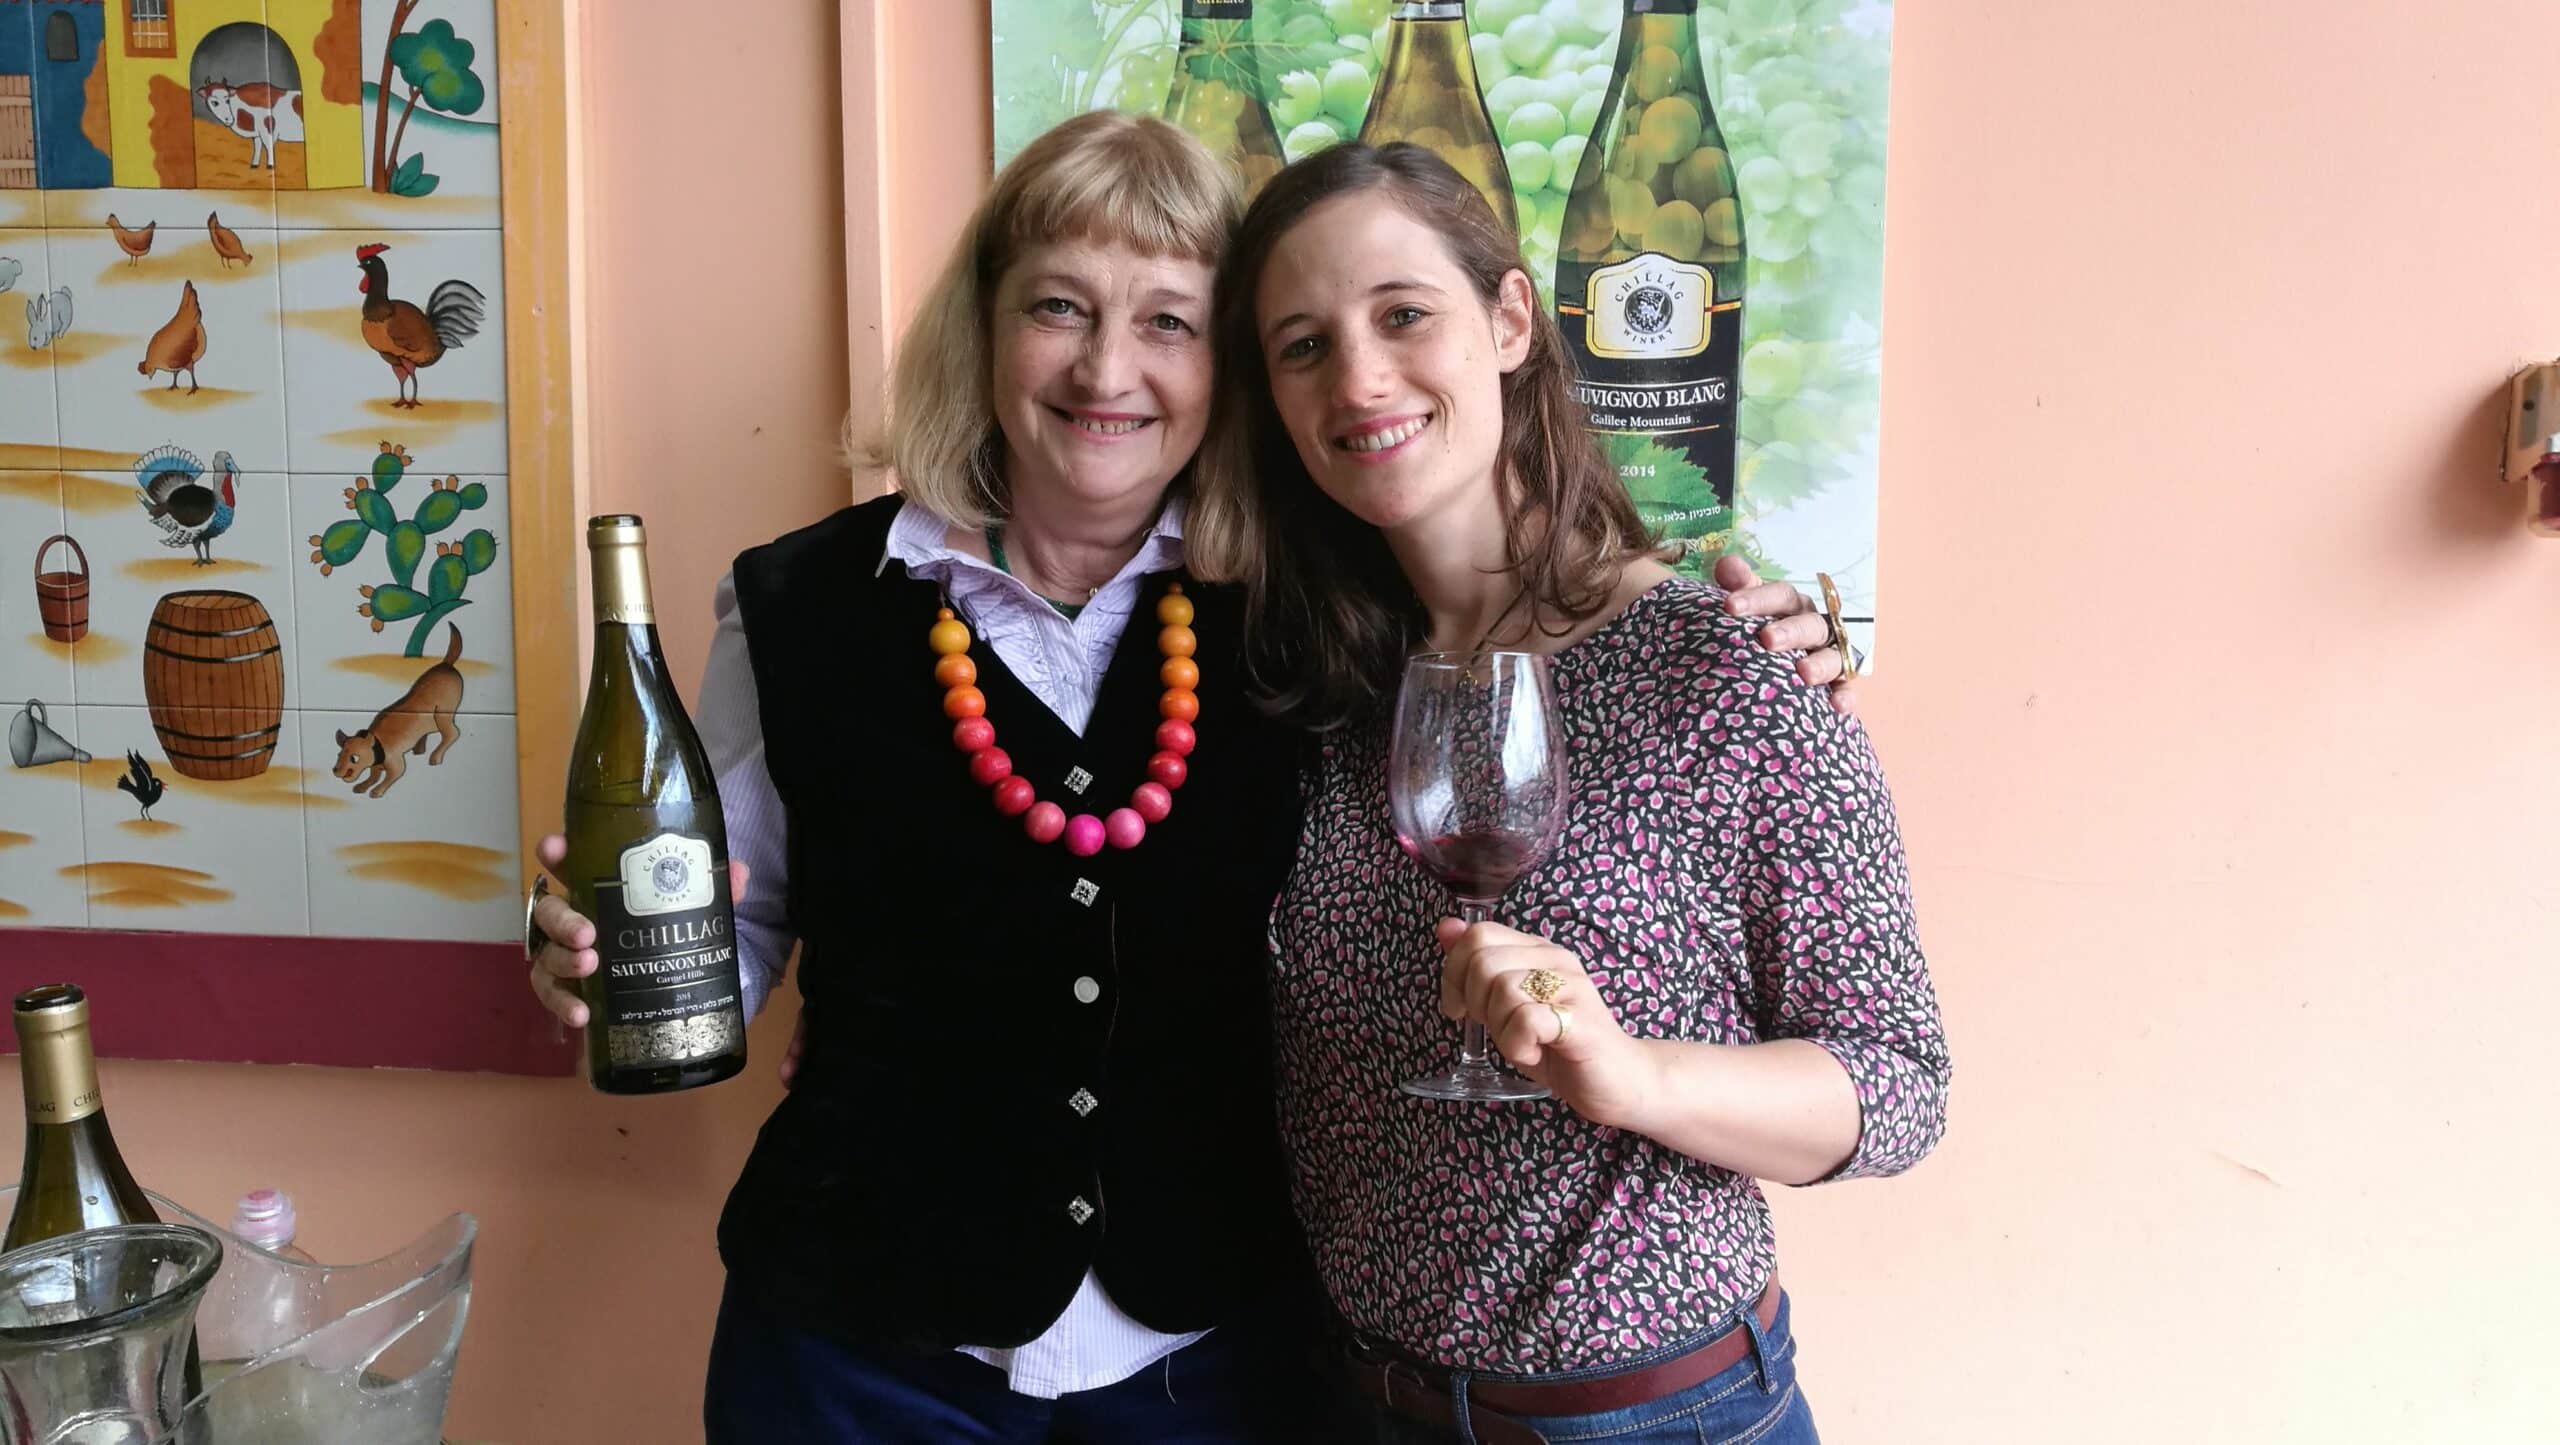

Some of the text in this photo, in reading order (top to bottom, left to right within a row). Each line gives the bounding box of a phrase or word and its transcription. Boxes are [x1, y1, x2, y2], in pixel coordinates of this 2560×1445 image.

[1615, 272, 1684, 302] CHILLAG
[1624, 328, 1673, 344] WINERY
[1576, 382, 1726, 408] UVIGNON BLANC
[1590, 413, 1691, 428] Galilee Mountains
[1619, 464, 1656, 478] 2014
[643, 845, 695, 872] CHILLAG
[618, 916, 724, 949] CHILLAG
[611, 946, 732, 977] SAUVIGNON BLANC
[656, 969, 705, 984] Carmel Hills
